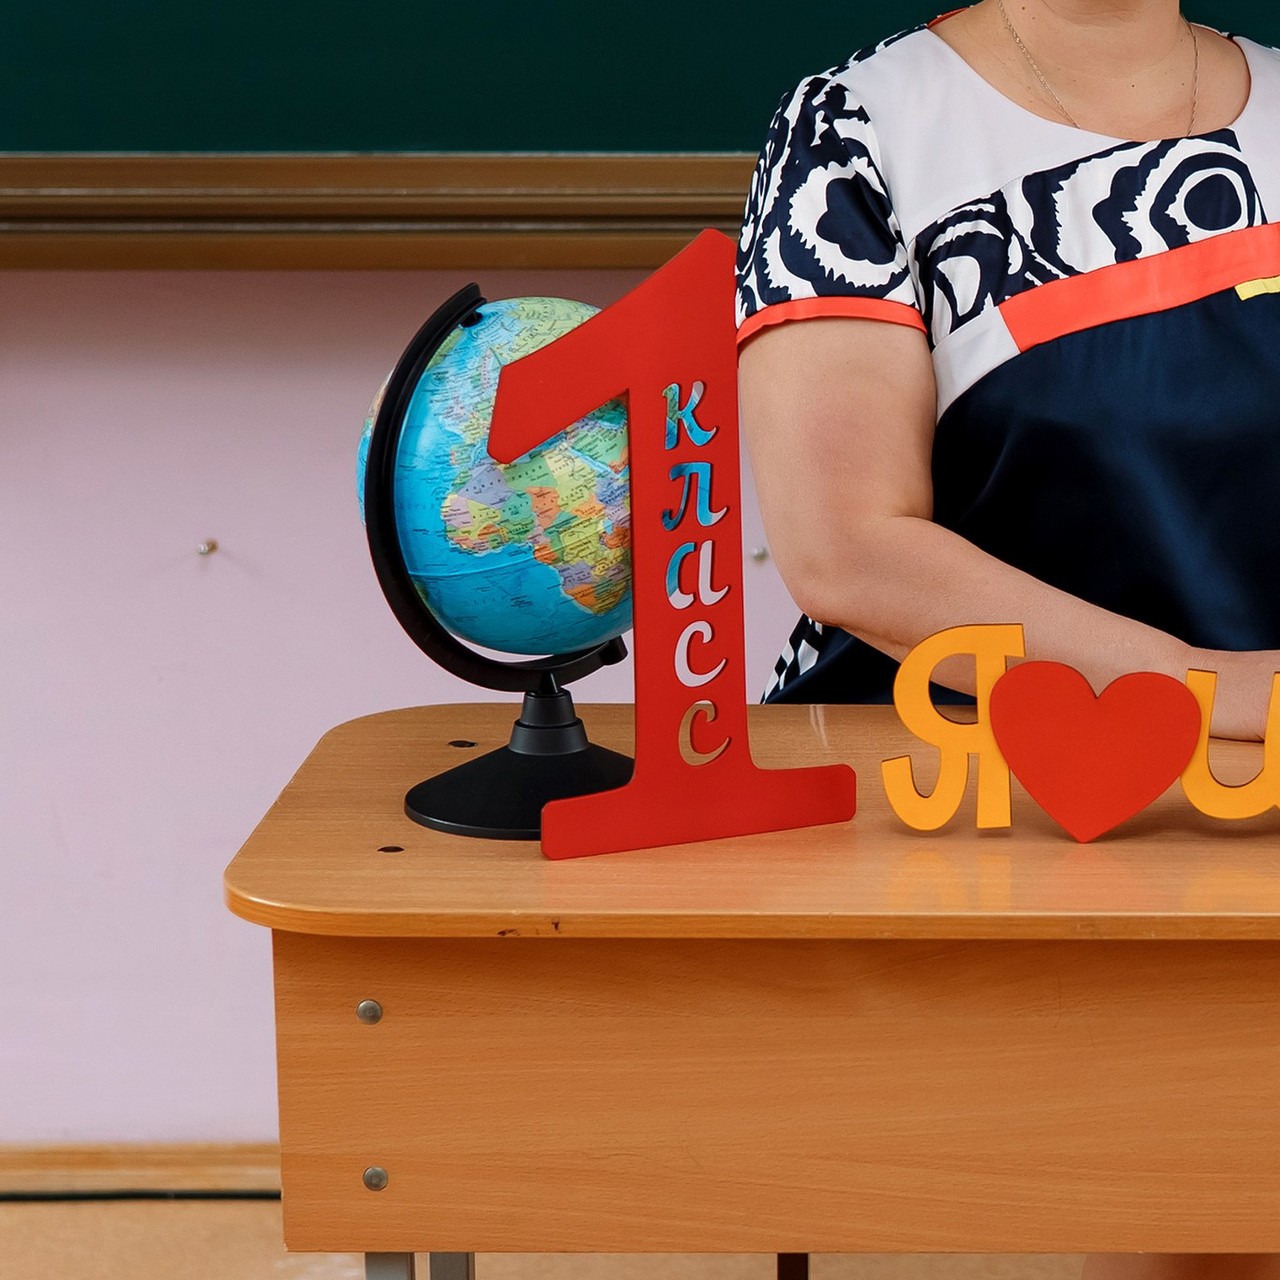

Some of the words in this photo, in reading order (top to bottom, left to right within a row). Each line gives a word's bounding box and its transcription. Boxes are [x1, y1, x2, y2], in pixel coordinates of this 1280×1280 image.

[489, 229, 857, 860] 1
[661, 380, 731, 767] класс
[881, 623, 1025, 831] Я
